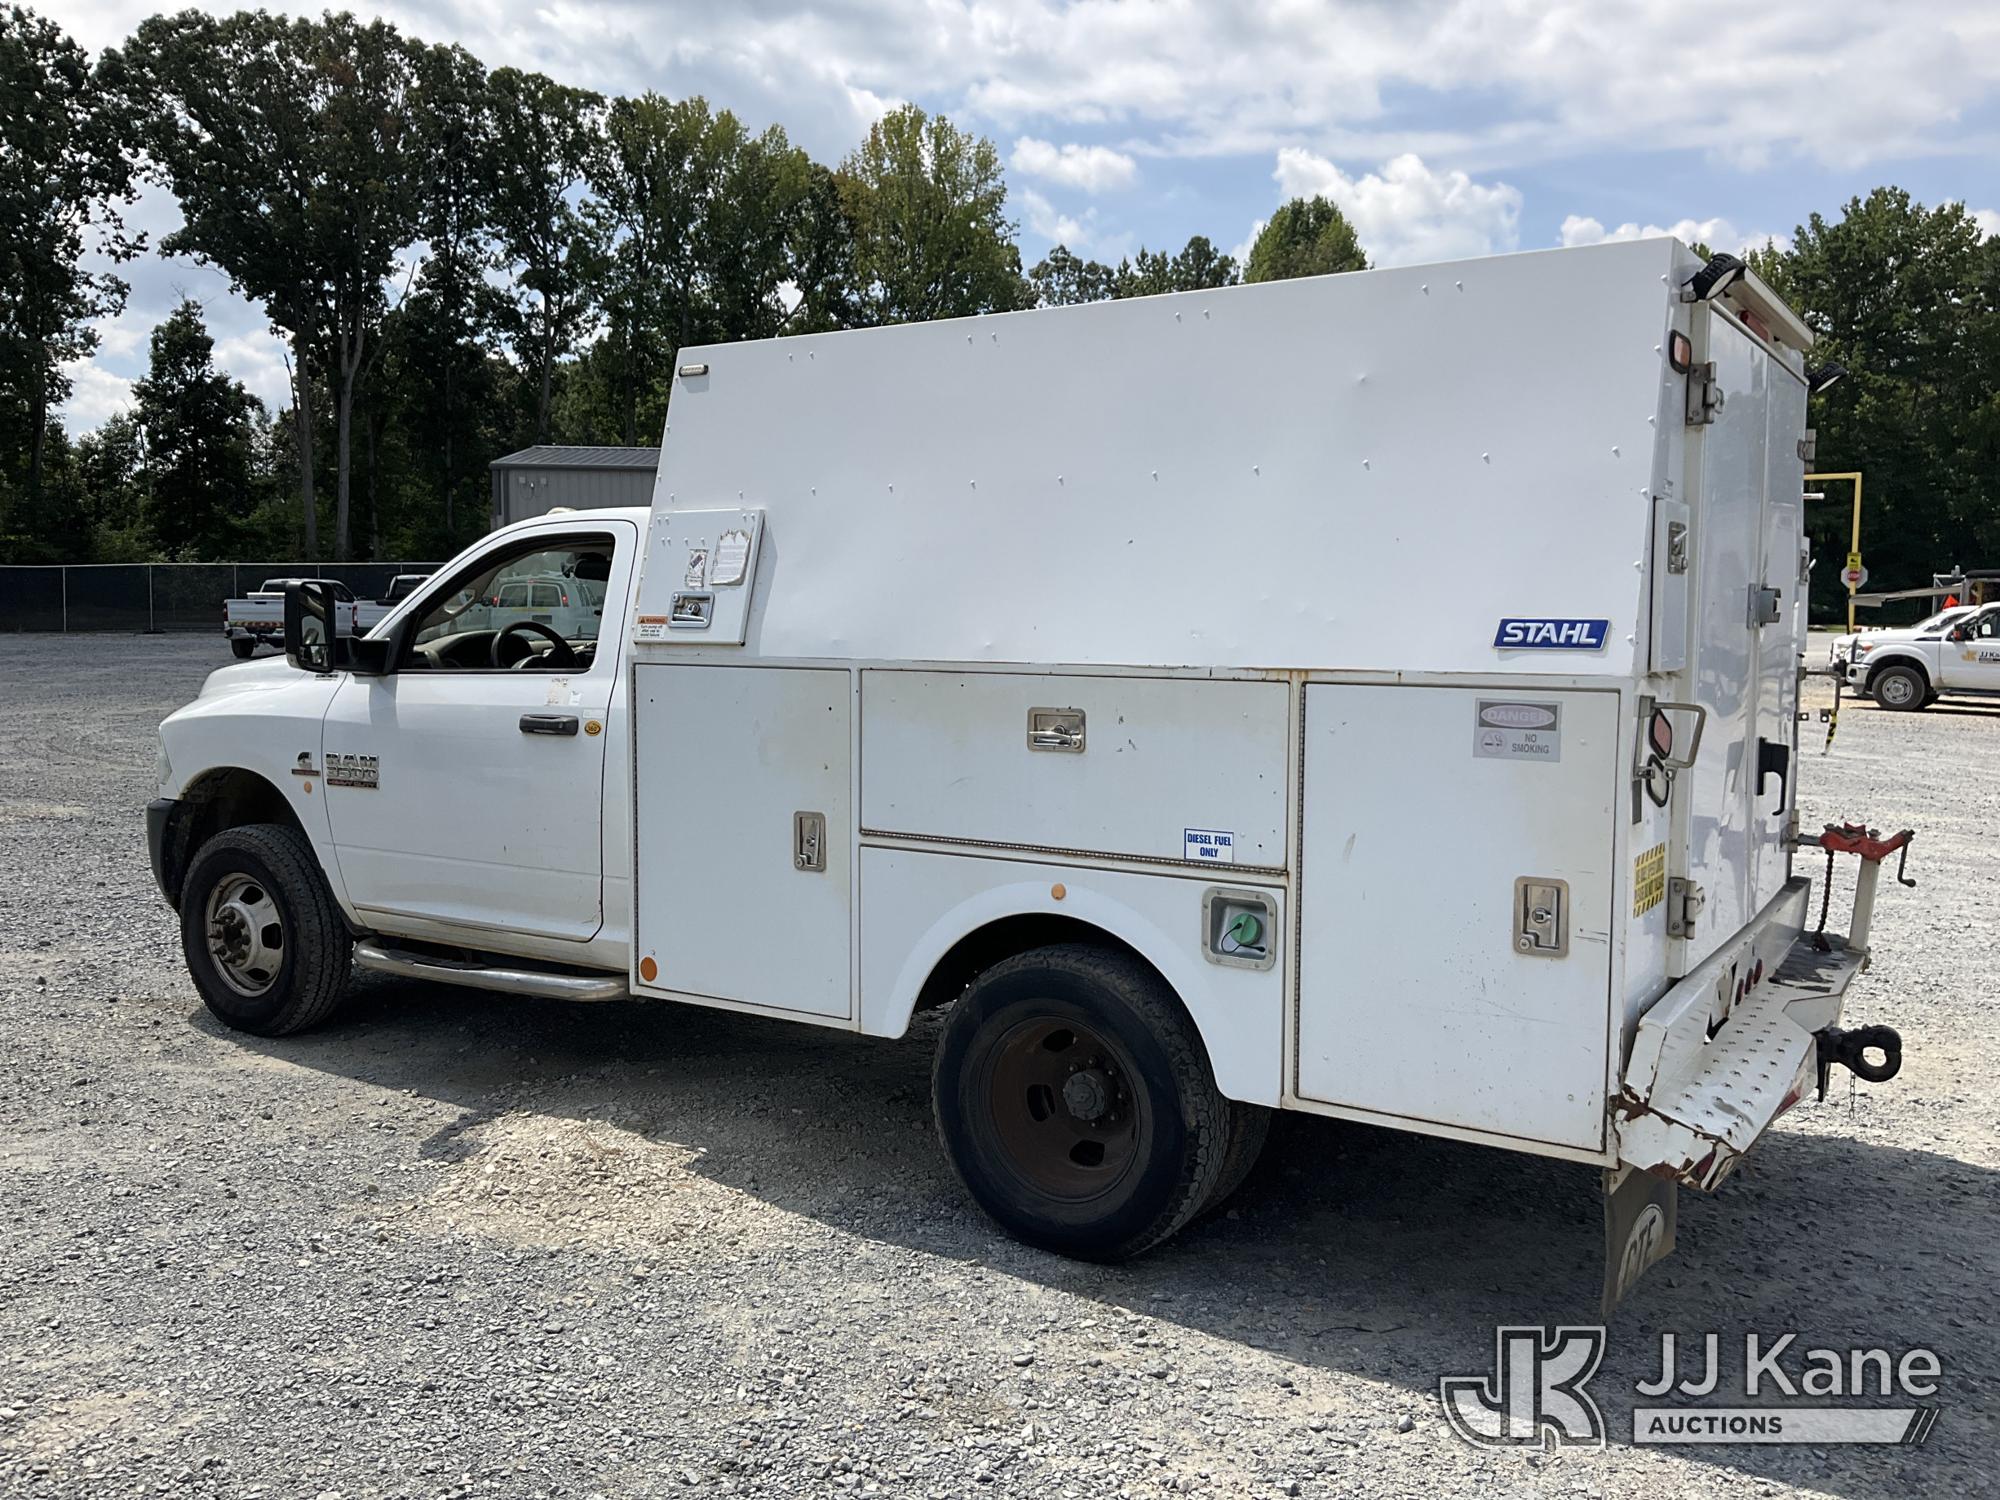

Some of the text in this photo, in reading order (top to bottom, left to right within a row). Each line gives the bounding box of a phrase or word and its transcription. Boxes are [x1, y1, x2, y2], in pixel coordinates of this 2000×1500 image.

[1502, 622, 1598, 644] STAHL
[1487, 709, 1549, 721] DANGER
[1525, 733, 1537, 743] NO
[1512, 743, 1550, 754] SMOKING
[326, 752, 379, 768] RAM
[1187, 833, 1232, 846] DIESEL FUEL
[1200, 847, 1218, 858] ONLY
